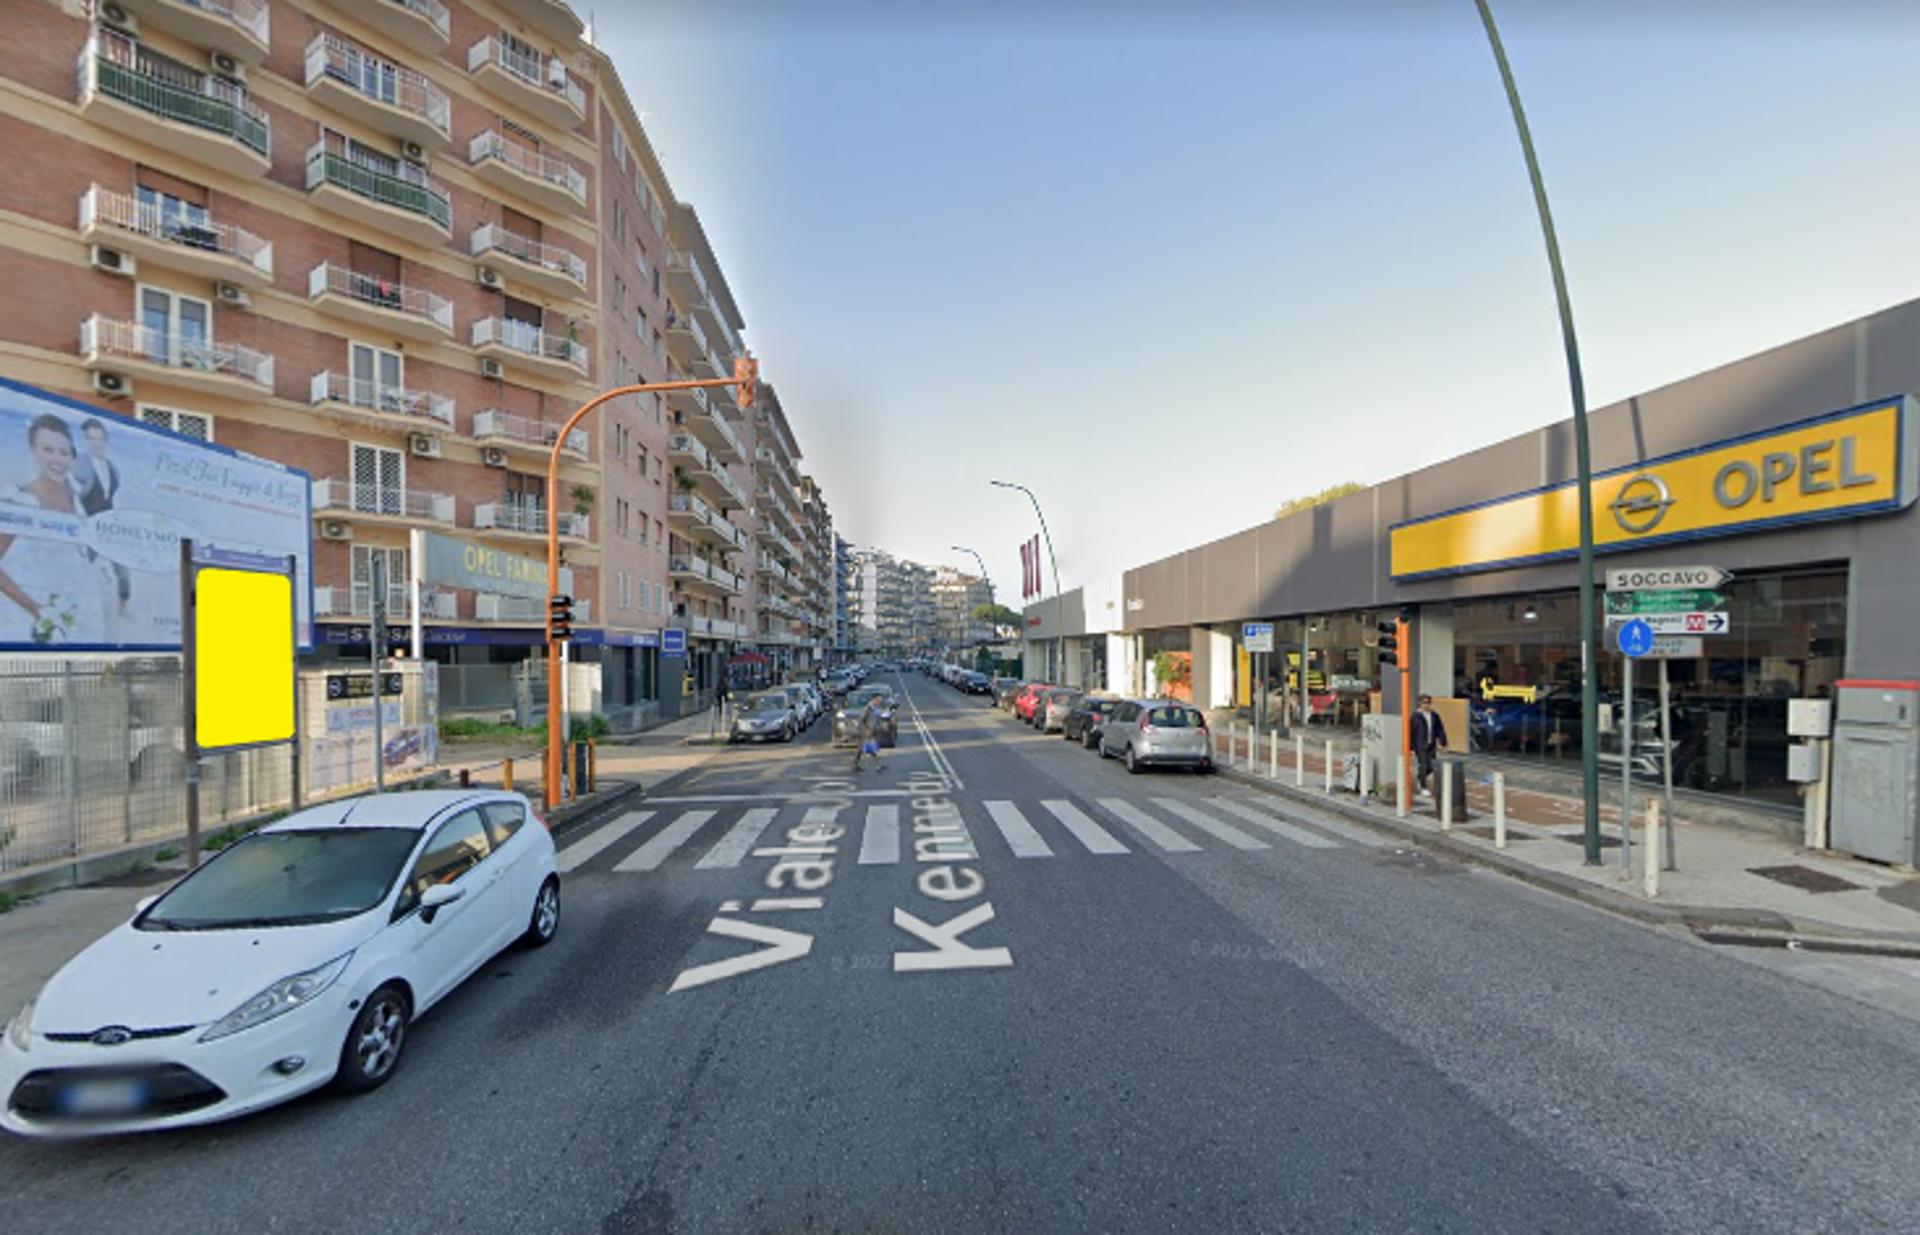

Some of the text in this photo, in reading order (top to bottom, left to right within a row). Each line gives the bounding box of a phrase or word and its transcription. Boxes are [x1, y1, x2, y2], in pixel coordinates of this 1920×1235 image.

[1713, 434, 1877, 509] OPEL
[96, 520, 180, 545] HONEYMO
[463, 544, 501, 577] OPEL
[1617, 570, 1710, 588] SOCCAVO
